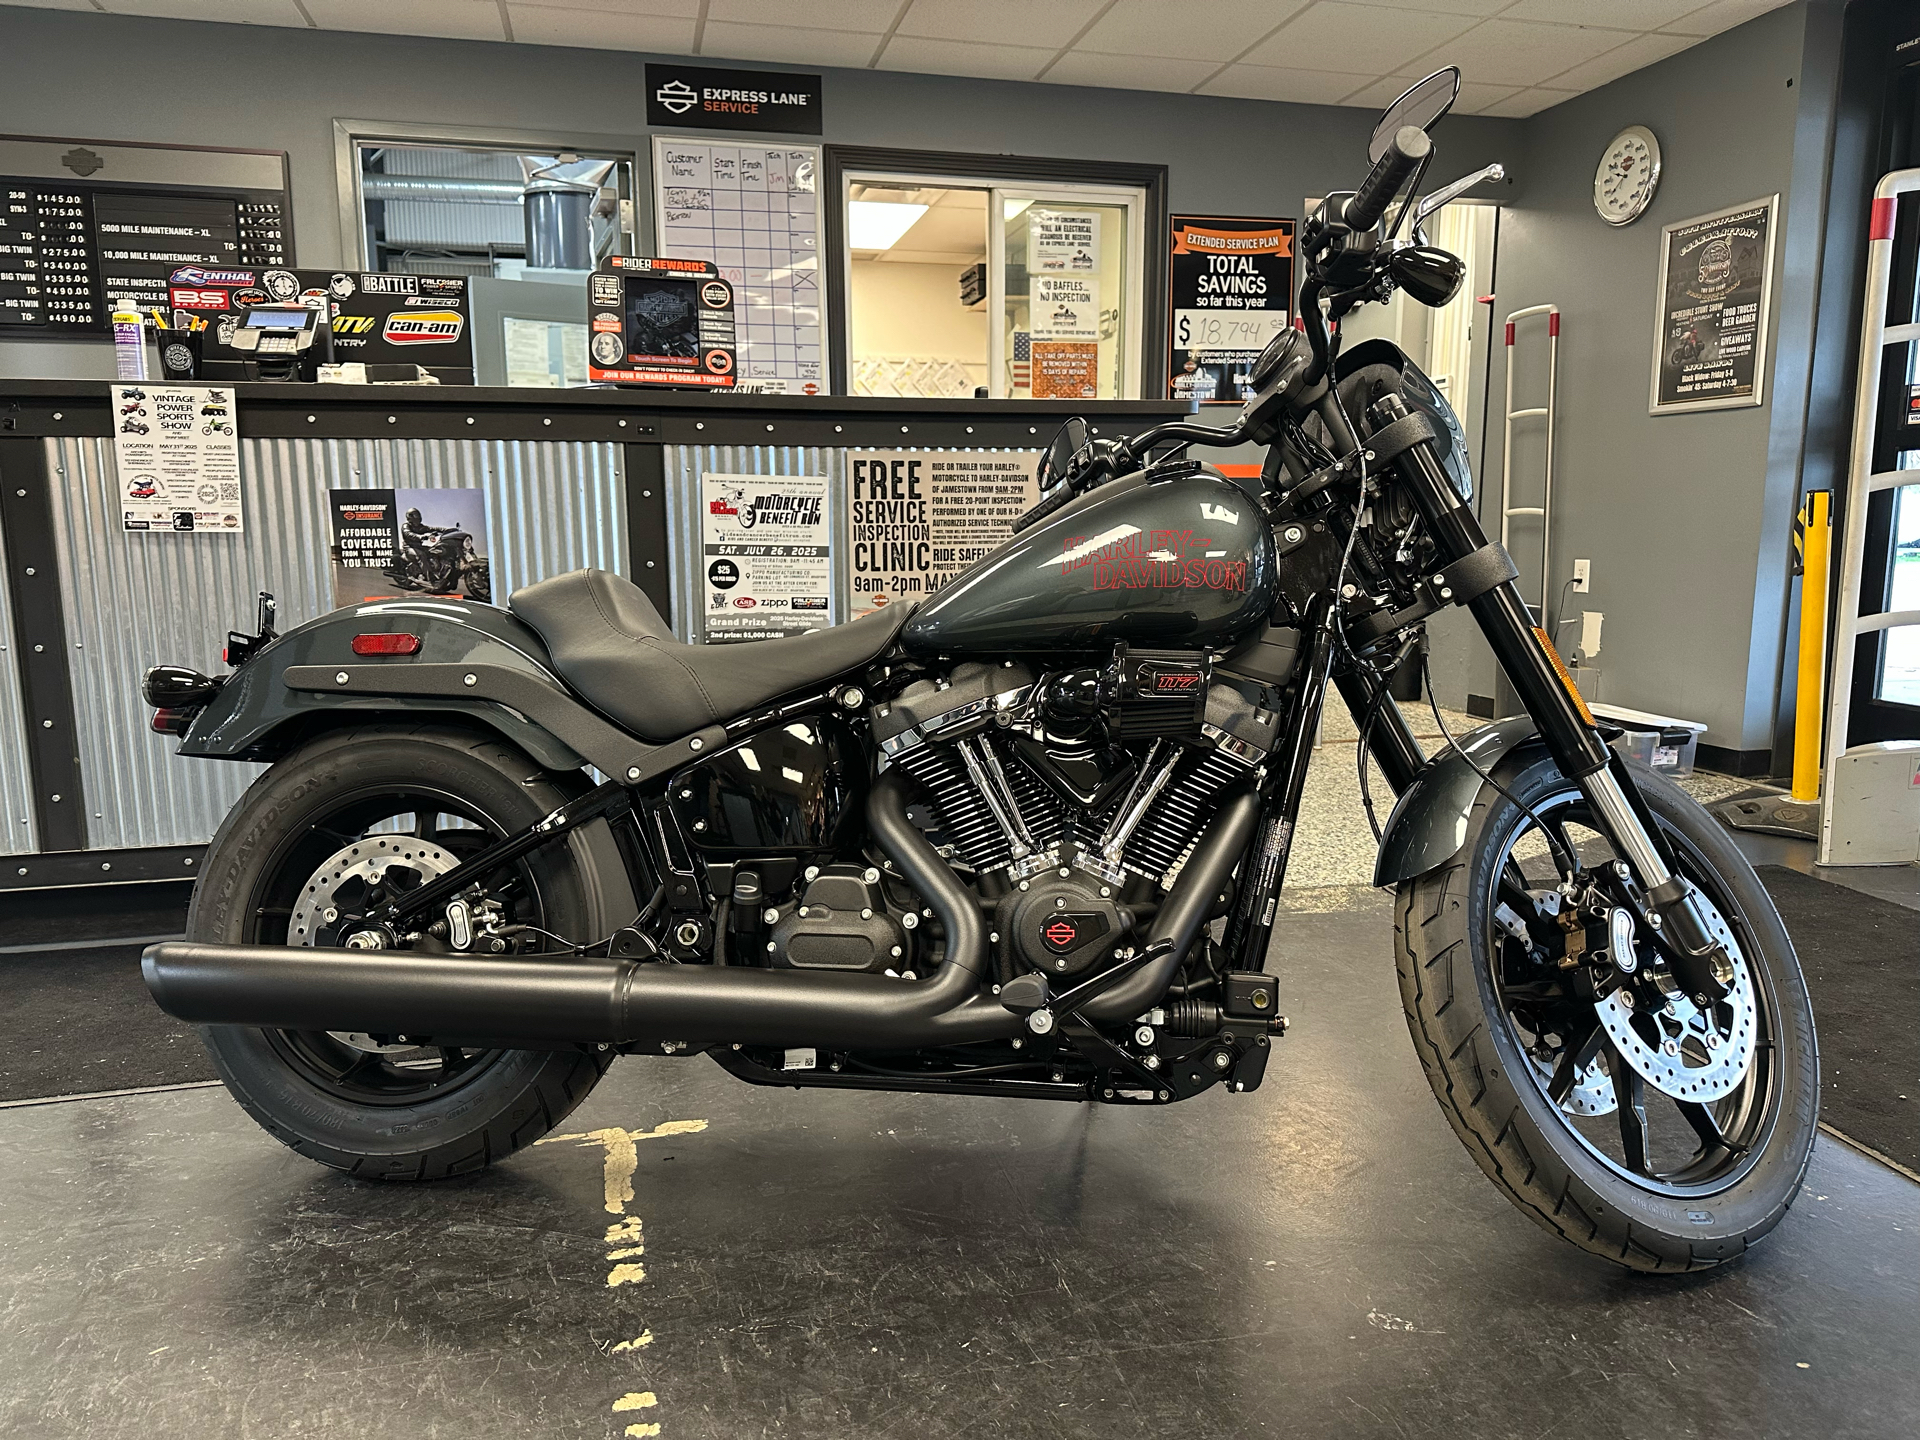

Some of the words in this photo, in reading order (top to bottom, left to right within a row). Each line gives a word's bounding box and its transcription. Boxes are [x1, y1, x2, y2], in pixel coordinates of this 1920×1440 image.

[703, 88, 767, 103] EXPRESS
[771, 93, 808, 105] LANE
[704, 101, 759, 114] SERVICE
[666, 152, 703, 164] Customer
[714, 159, 735, 168] Start
[672, 165, 695, 177] Name
[714, 171, 735, 179] Time
[37, 194, 81, 204] $145.00
[39, 208, 82, 217] $175.00
[101, 224, 120, 233] 5000
[121, 225, 140, 234] MILE
[141, 226, 193, 236] MAINTENANCE
[201, 229, 211, 237] XL
[1064, 225, 1092, 233] ELECTRICAL
[1187, 233, 1225, 249] EXTENDED
[1227, 238, 1258, 250] SERVICE
[1259, 235, 1279, 248] PLAN
[12, 245, 33, 254] TWIN
[42, 248, 86, 257] $275.00
[103, 251, 129, 260] 10,000
[130, 252, 149, 260] MILE
[149, 253, 202, 262] MAINTENANCE
[210, 255, 219, 263] XL
[622, 257, 651, 269] RIDER
[1207, 255, 1259, 274] TOTAL
[1, 272, 14, 281] BIG
[15, 273, 36, 281] TWIN
[45, 275, 88, 283] $335.00
[107, 278, 129, 287] STATE
[370, 277, 415, 293] BATTLE
[1198, 275, 1267, 294] SAVINGS
[107, 291, 161, 300] MOTORCYCLE
[173, 290, 225, 304] BS
[1040, 292, 1050, 301] NO
[1052, 293, 1090, 302] INSPECTION
[5, 300, 19, 308] BIG
[20, 300, 39, 308] TWIN
[1197, 297, 1208, 307] so
[1210, 295, 1224, 307] far
[1225, 296, 1242, 307] this
[1245, 298, 1267, 310] year
[1709, 302, 1724, 312] SHOW
[1722, 307, 1736, 317] FOOD
[1737, 303, 1757, 315] TRUCKS
[1693, 314, 1713, 322] SATURDAY
[1722, 316, 1734, 327] BEER
[1736, 313, 1756, 325] GARDEN
[389, 321, 458, 334] can-am
[1179, 315, 1191, 346] $
[1195, 318, 1261, 346] 18,794
[1720, 333, 1752, 346] GIVEAWAYS
[635, 373, 668, 381] REWARDS
[668, 374, 702, 383] PROGRAM
[703, 376, 725, 384] TODAY!
[152, 395, 196, 403] VINTAGE
[157, 404, 193, 412] POWER
[157, 413, 194, 421] SPORTS
[161, 422, 192, 430] SHOW
[932, 463, 945, 471] RIDE
[947, 463, 954, 471] OR
[956, 463, 977, 471] TRAILER
[979, 463, 993, 471] YOUR
[853, 460, 922, 500] FREE
[932, 474, 970, 482] MOTORCYCLE
[971, 474, 978, 482] TO
[979, 474, 1029, 483] HARLEY-DAVIDSON
[941, 486, 977, 494] JAMESTOWN
[978, 486, 994, 494] FROM
[995, 486, 1024, 494] 9AM-2PM
[754, 494, 822, 511] MOTORCYCLE
[932, 497, 944, 505] FOR
[951, 497, 964, 505] FREE
[965, 497, 990, 505] 20-POINT
[759, 510, 801, 524] BENEFIT
[800, 511, 821, 525] RUN
[853, 501, 927, 524] SERVICE
[932, 508, 966, 516] PERFORMED
[968, 508, 975, 516] BY
[976, 508, 986, 516] ONE
[996, 508, 1007, 516] OUR
[932, 519, 966, 527] AUTHORIZED
[968, 519, 989, 527] SERVICE
[340, 528, 392, 537] AFFORDABLE
[853, 524, 930, 541] INSPECTION
[341, 538, 393, 549] COVERAGE
[719, 546, 739, 555] SAT.
[744, 546, 766, 555] JULY
[771, 547, 787, 556] 26,
[791, 547, 817, 556] 2025
[933, 548, 955, 561] RIDE
[854, 542, 930, 572] CLINIC
[342, 558, 361, 568] YOU
[364, 558, 394, 568] TRUST.
[717, 565, 730, 574] $25
[1094, 559, 1246, 591] DAVIDSON
[854, 575, 921, 596] 9am-2pm
[761, 598, 788, 608] zippo
[710, 618, 740, 626] Grand
[742, 618, 767, 626] Prize
[1158, 676, 1199, 688] 117
[418, 757, 497, 796] SCORCHER
